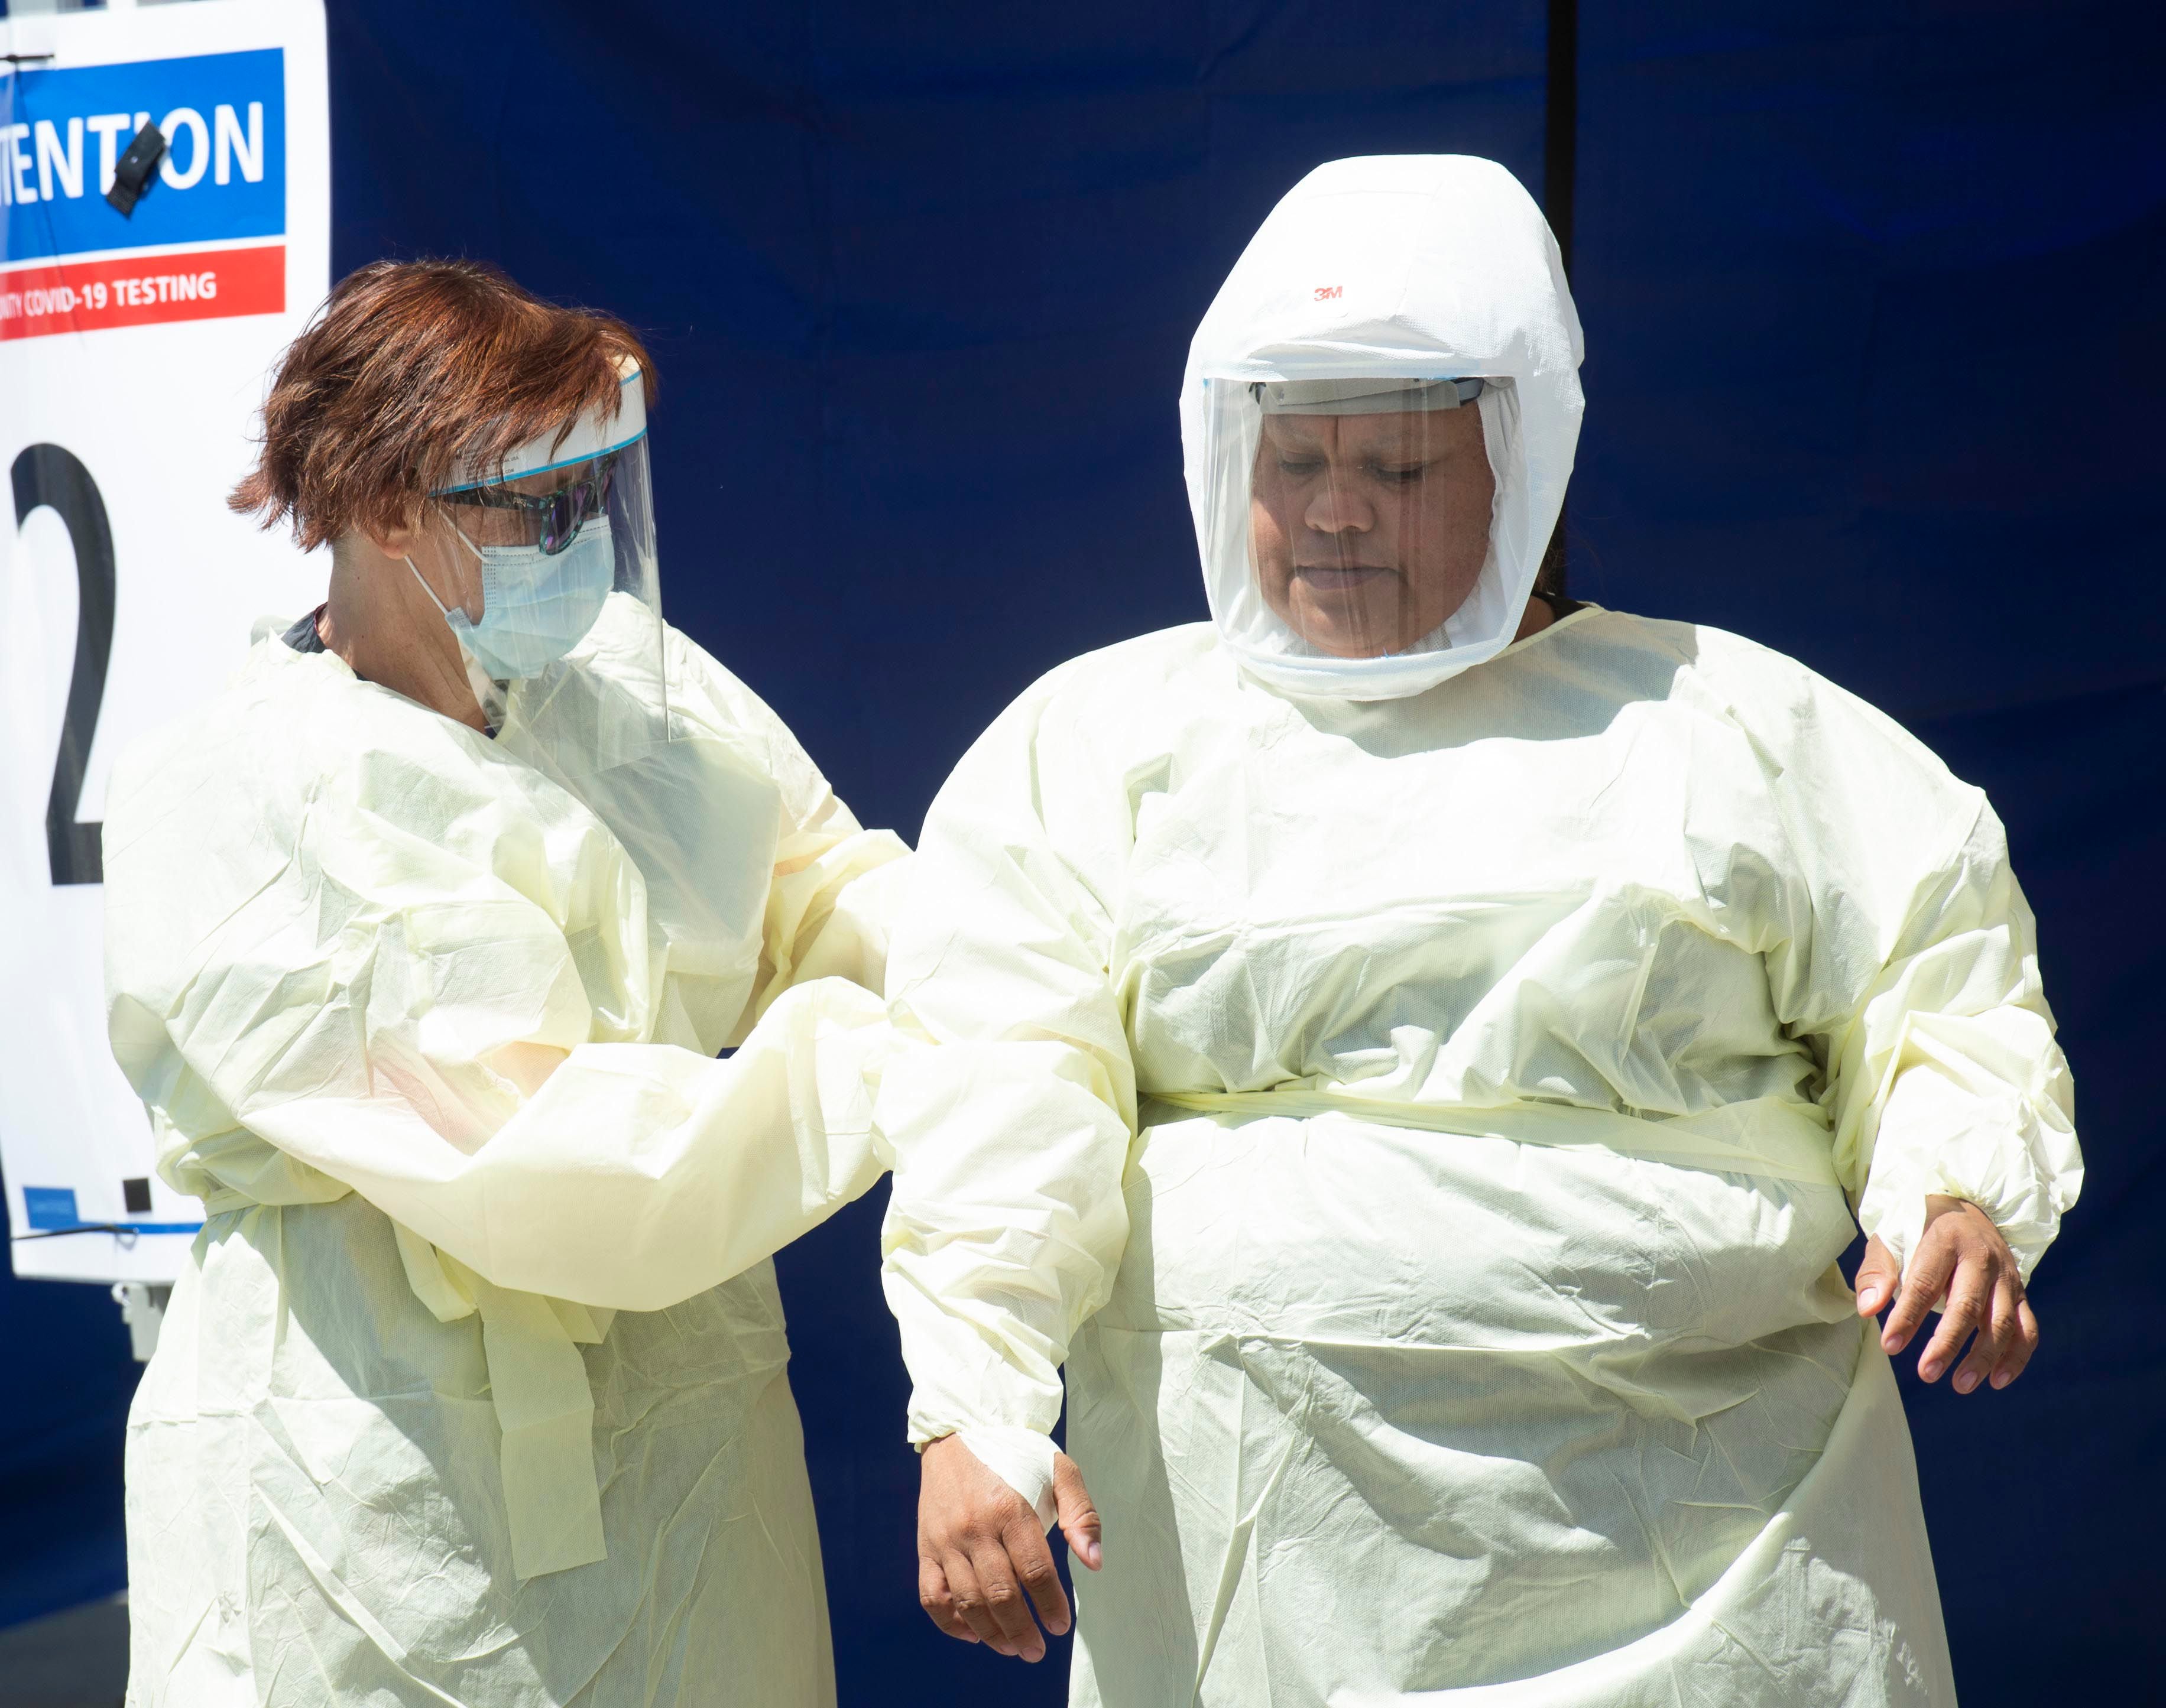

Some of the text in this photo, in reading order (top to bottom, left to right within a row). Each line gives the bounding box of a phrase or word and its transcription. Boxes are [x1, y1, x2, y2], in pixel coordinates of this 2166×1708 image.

[24, 281, 108, 317] COVID-19
[111, 271, 217, 307] TESTING
[1314, 285, 1343, 301] 3M
[11, 441, 116, 886] 2
